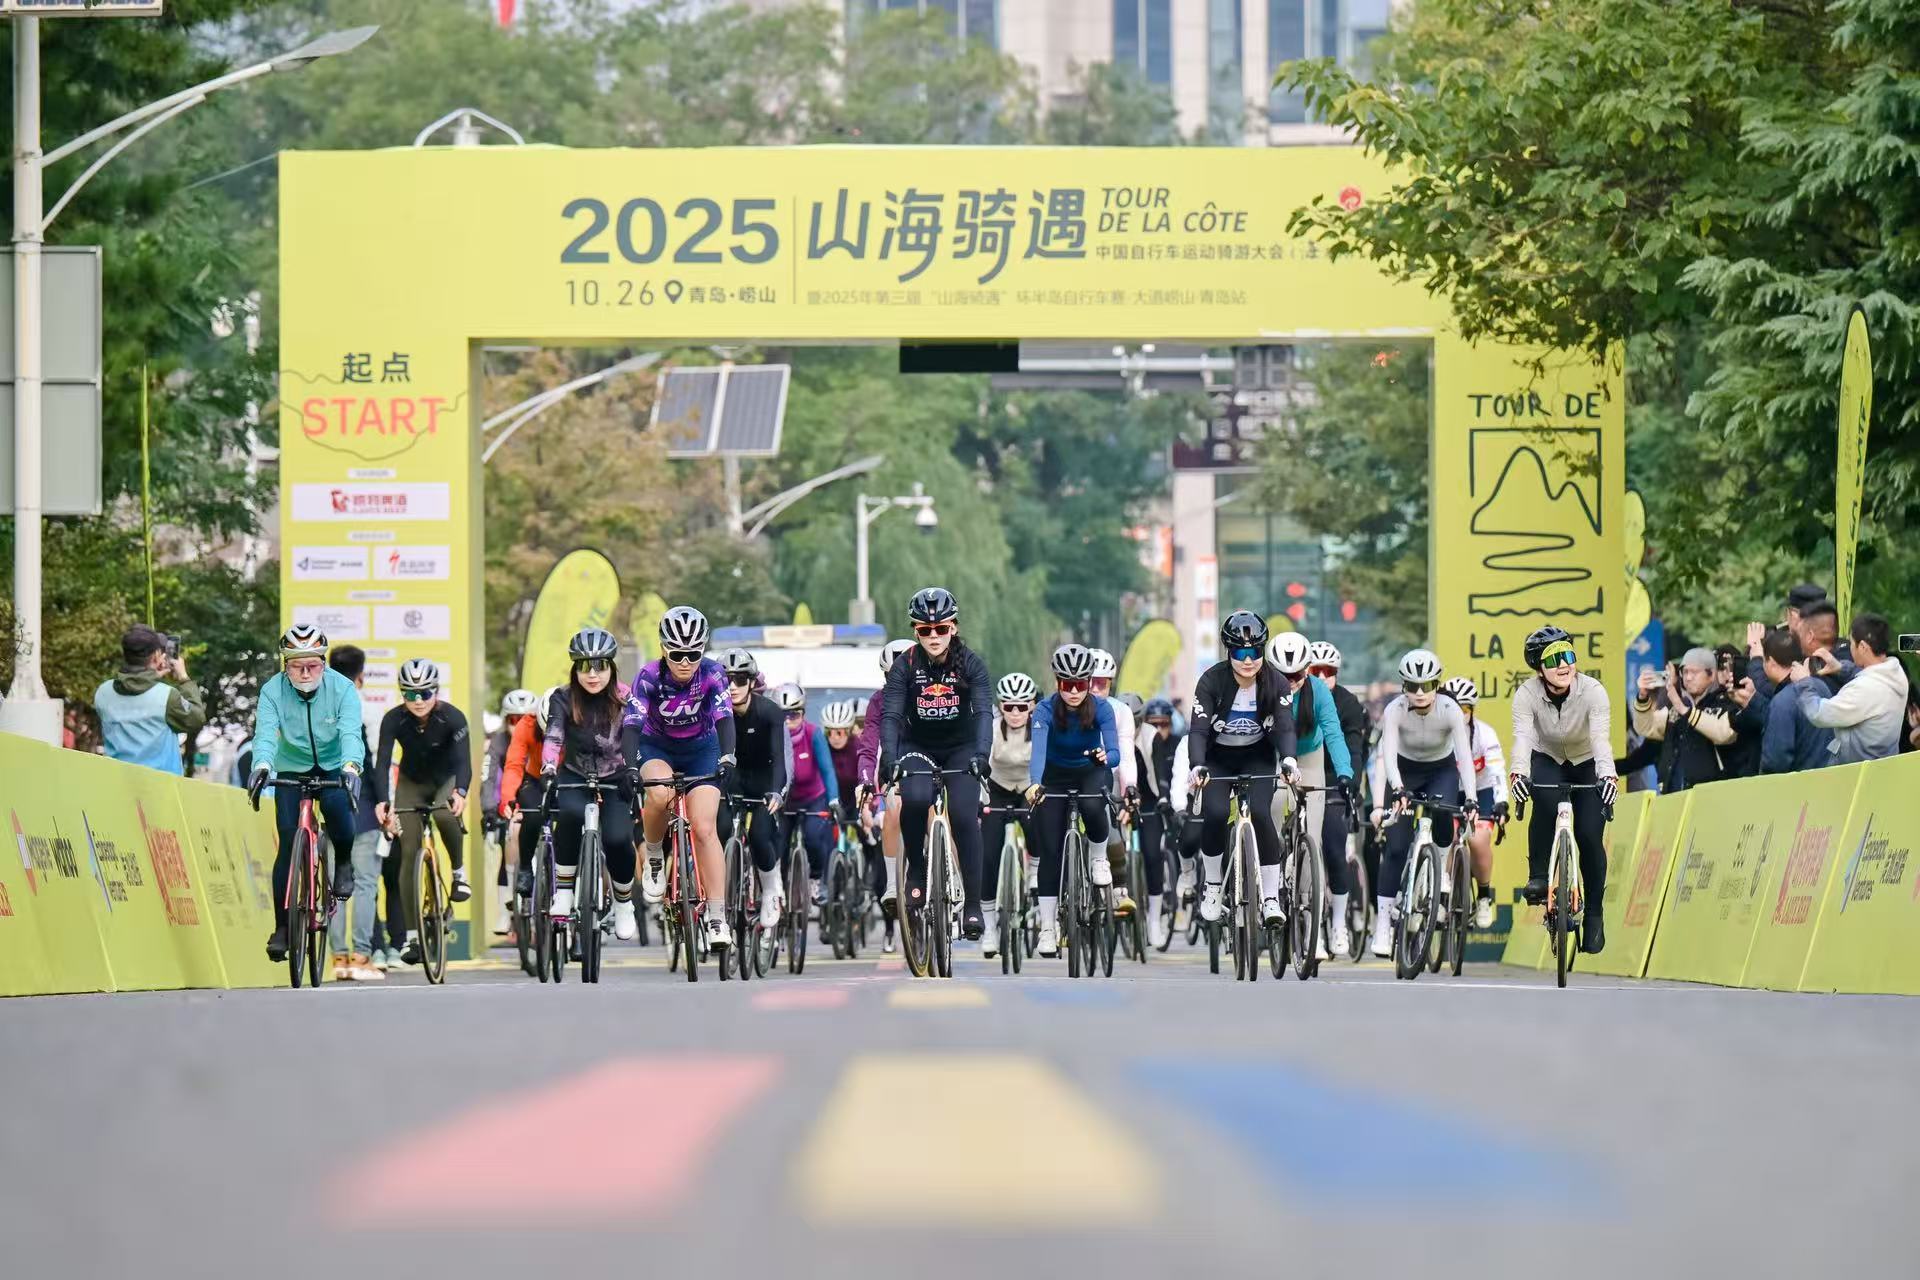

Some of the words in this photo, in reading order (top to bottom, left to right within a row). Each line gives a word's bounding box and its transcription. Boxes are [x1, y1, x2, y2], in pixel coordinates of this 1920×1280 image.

[1101, 187, 1171, 209] TOUR
[560, 198, 780, 264] 2025
[1097, 211, 1131, 233] DE
[1142, 211, 1171, 233] LA
[1184, 201, 1249, 233] CÔTE
[807, 188, 1087, 285] 山海骑遇
[565, 280, 654, 305] 10.26
[340, 351, 411, 383] 起点
[303, 397, 446, 436] START
[1468, 393, 1552, 418] TOUR
[1565, 392, 1601, 418] DE
[1470, 633, 1504, 659] LA
[1470, 669, 1602, 699] 山海
[917, 706, 960, 716] BORA
